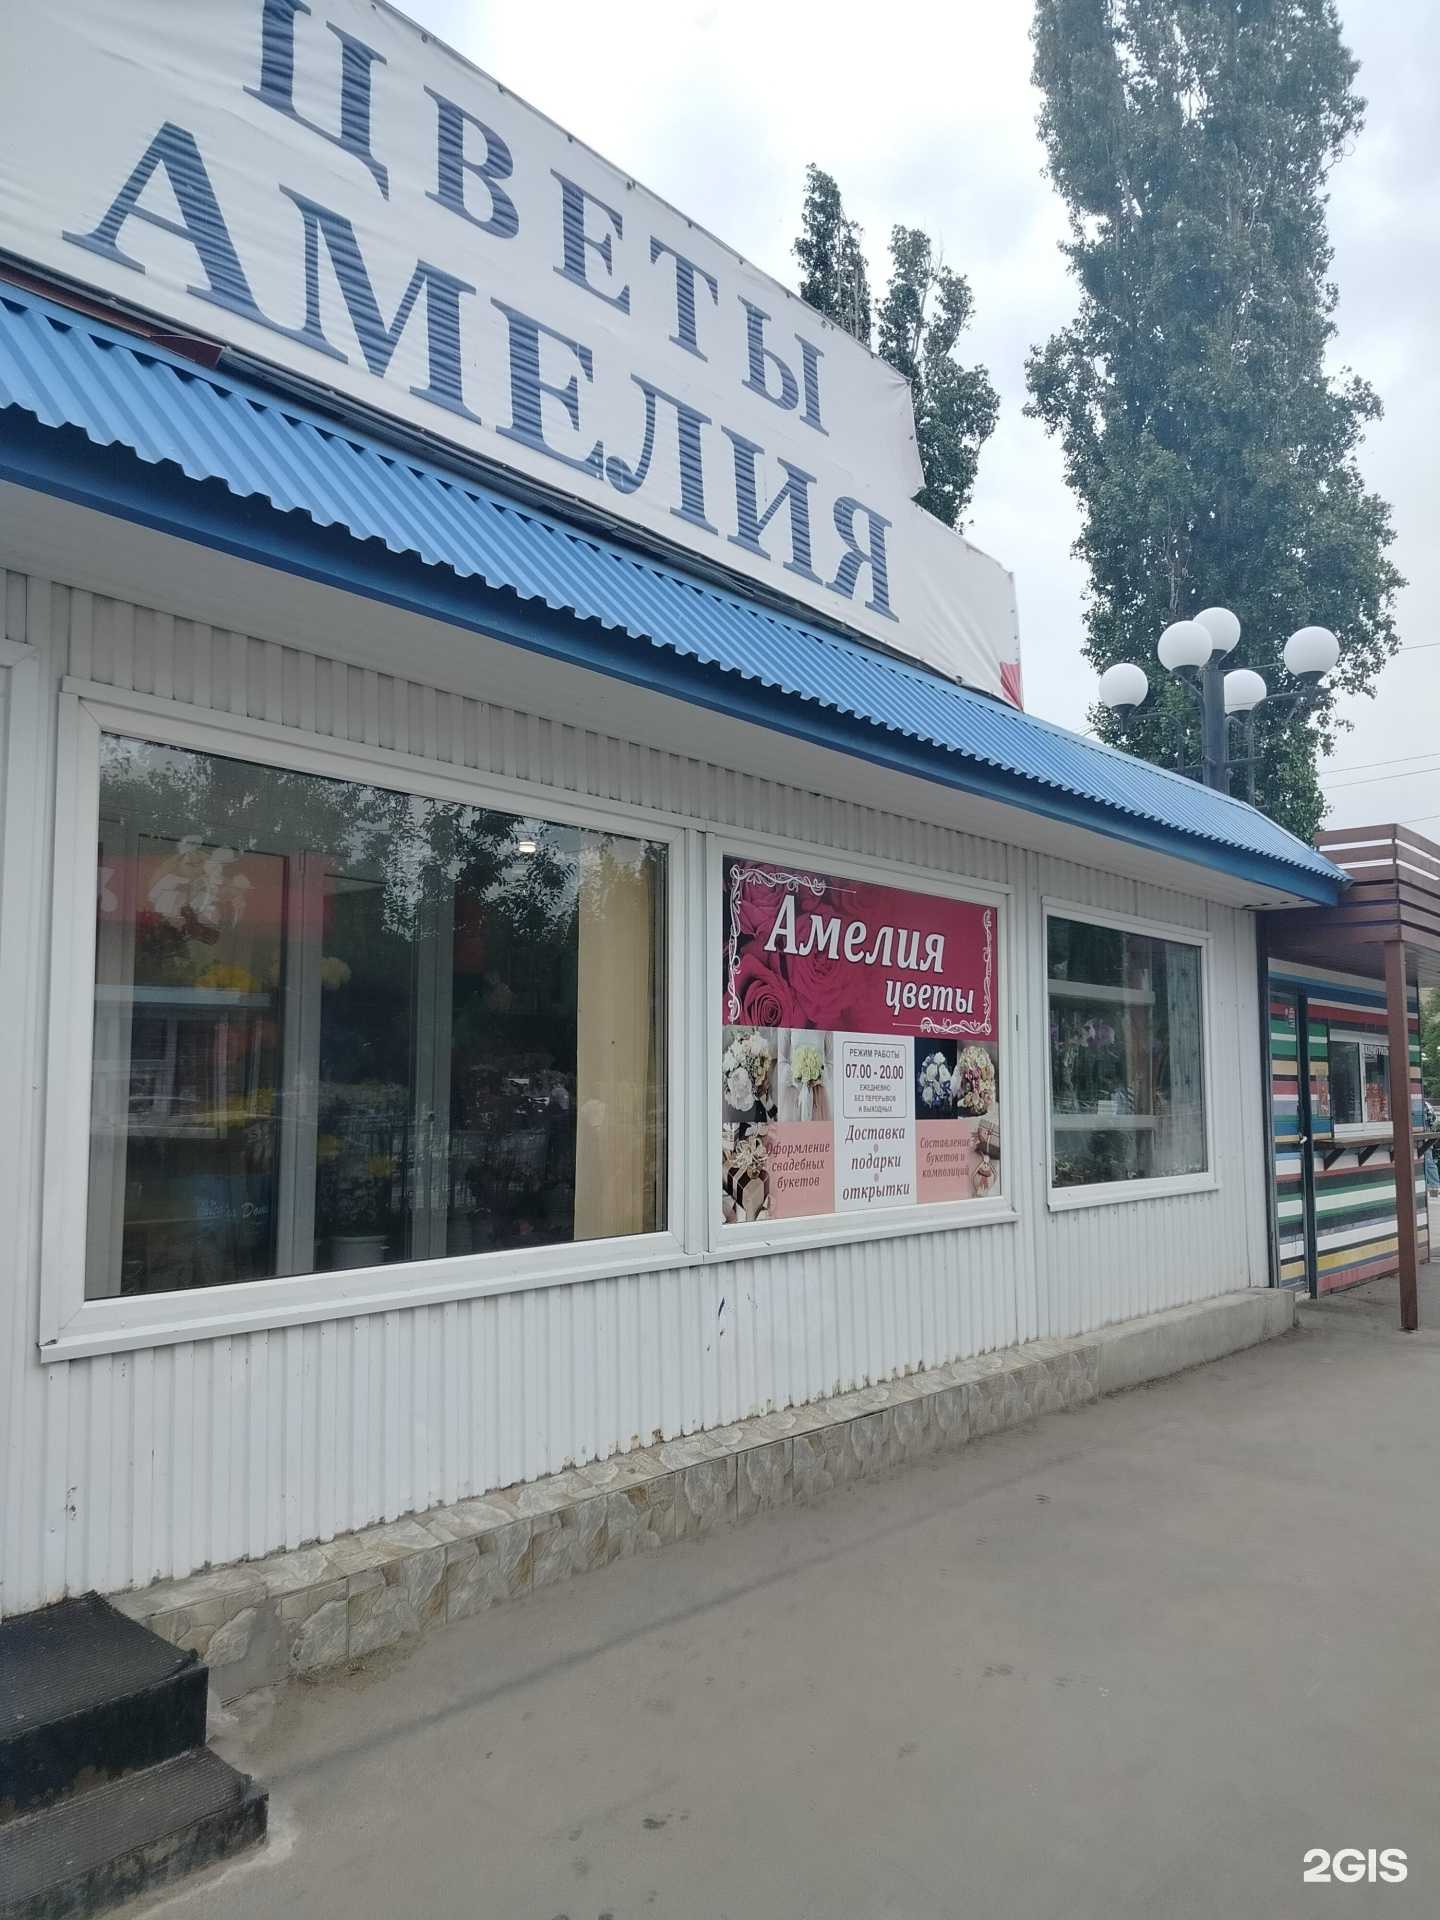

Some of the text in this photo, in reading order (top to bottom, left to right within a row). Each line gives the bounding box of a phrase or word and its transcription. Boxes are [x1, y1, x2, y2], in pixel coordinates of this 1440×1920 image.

[242, 0, 829, 436] ЦВЕТЫ
[62, 120, 900, 623] АМЕЛИЯ
[763, 894, 945, 973] Амелия
[885, 979, 974, 1015] цветы
[849, 1048, 900, 1058] РЕЖИМ РАБОТЫ
[845, 1063, 872, 1079] 07.00
[879, 1064, 904, 1080] 20.00
[845, 1125, 905, 1144] Доставка
[765, 1141, 830, 1157] Оформление
[772, 1158, 825, 1172] свадебных
[851, 1153, 902, 1172] подарки
[777, 1176, 820, 1192] букетов
[842, 1184, 910, 1202] открытки
